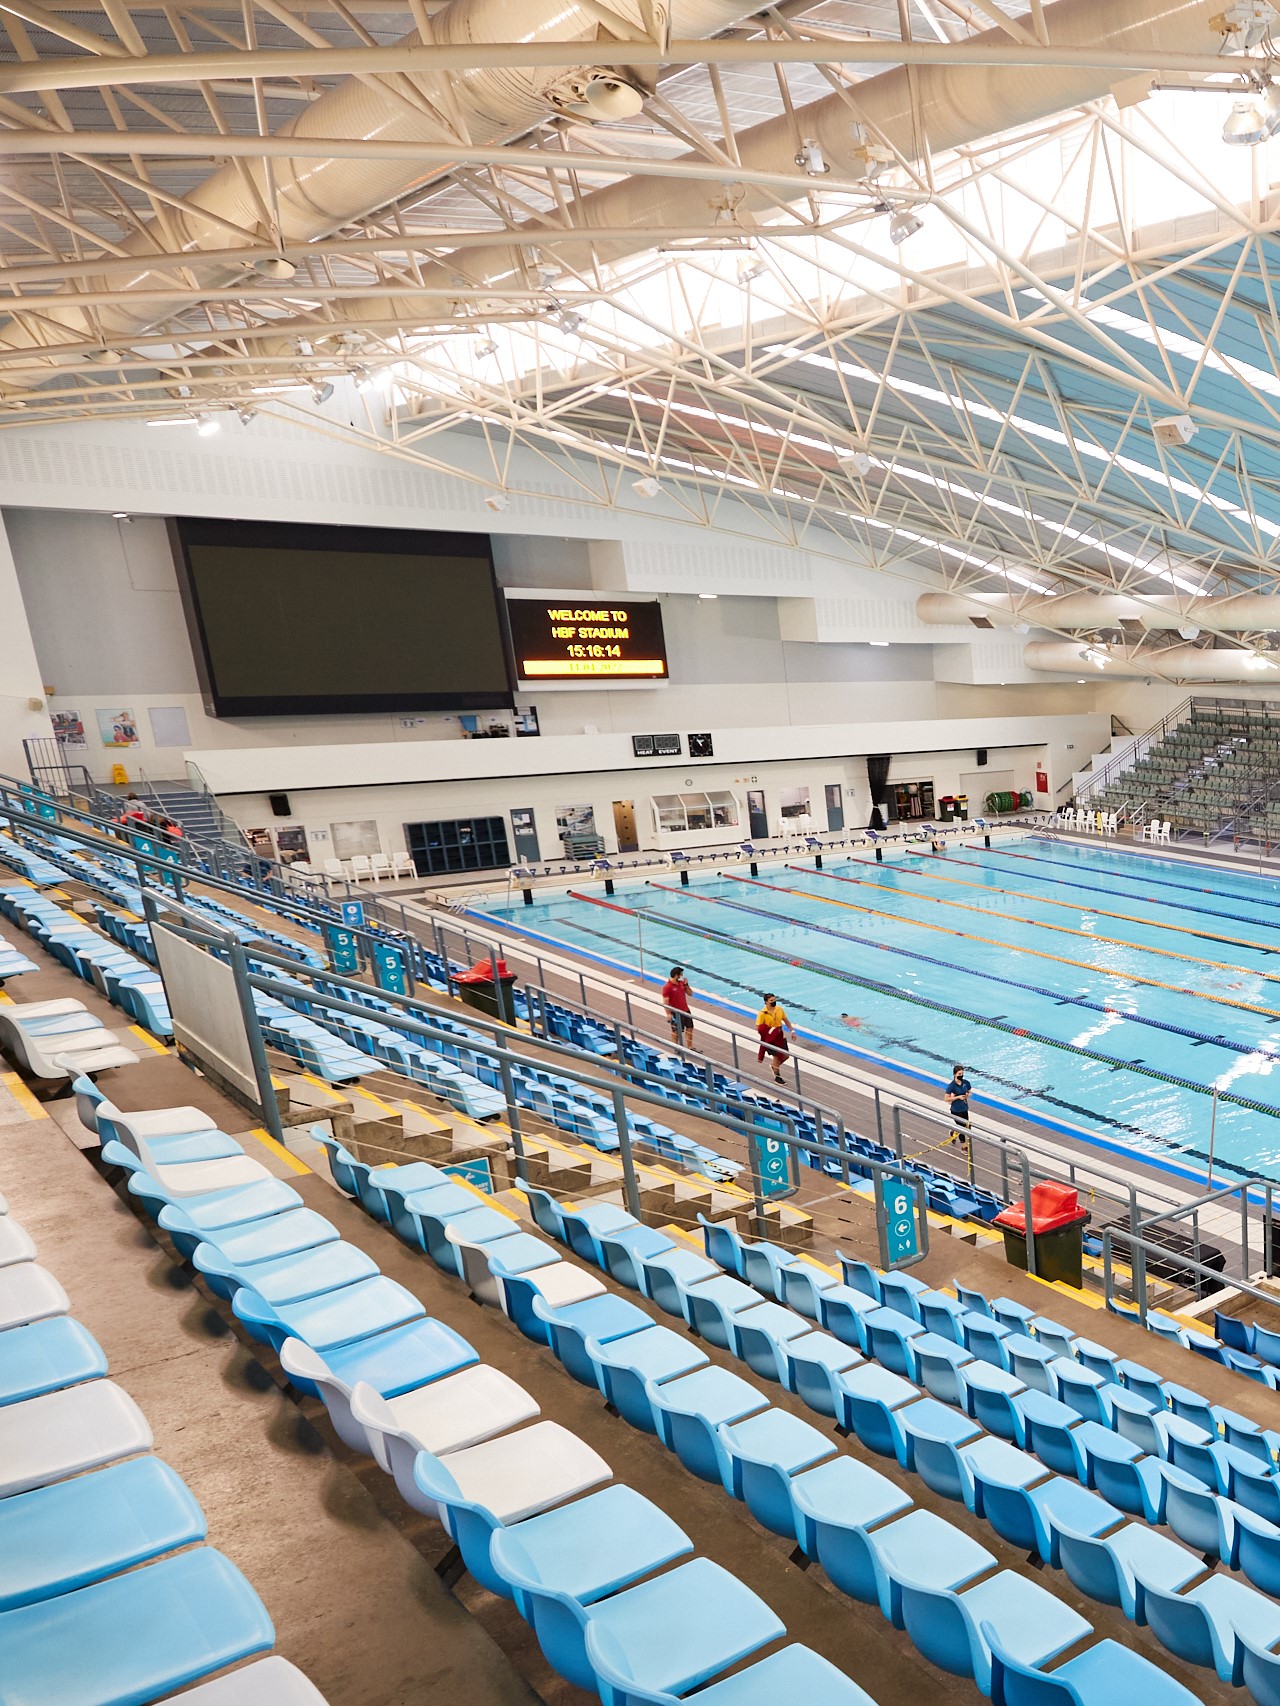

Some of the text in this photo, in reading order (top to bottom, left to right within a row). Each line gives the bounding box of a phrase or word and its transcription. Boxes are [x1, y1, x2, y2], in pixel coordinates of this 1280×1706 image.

[547, 609, 628, 622] WELCOME TO
[551, 626, 629, 639] HBF STADIUM
[566, 644, 621, 657] 15:16:14
[141, 842, 150, 851] 4
[337, 933, 349, 945] 5
[385, 956, 397, 969] 5
[766, 1137, 780, 1153] 6
[894, 1195, 908, 1215] 6
